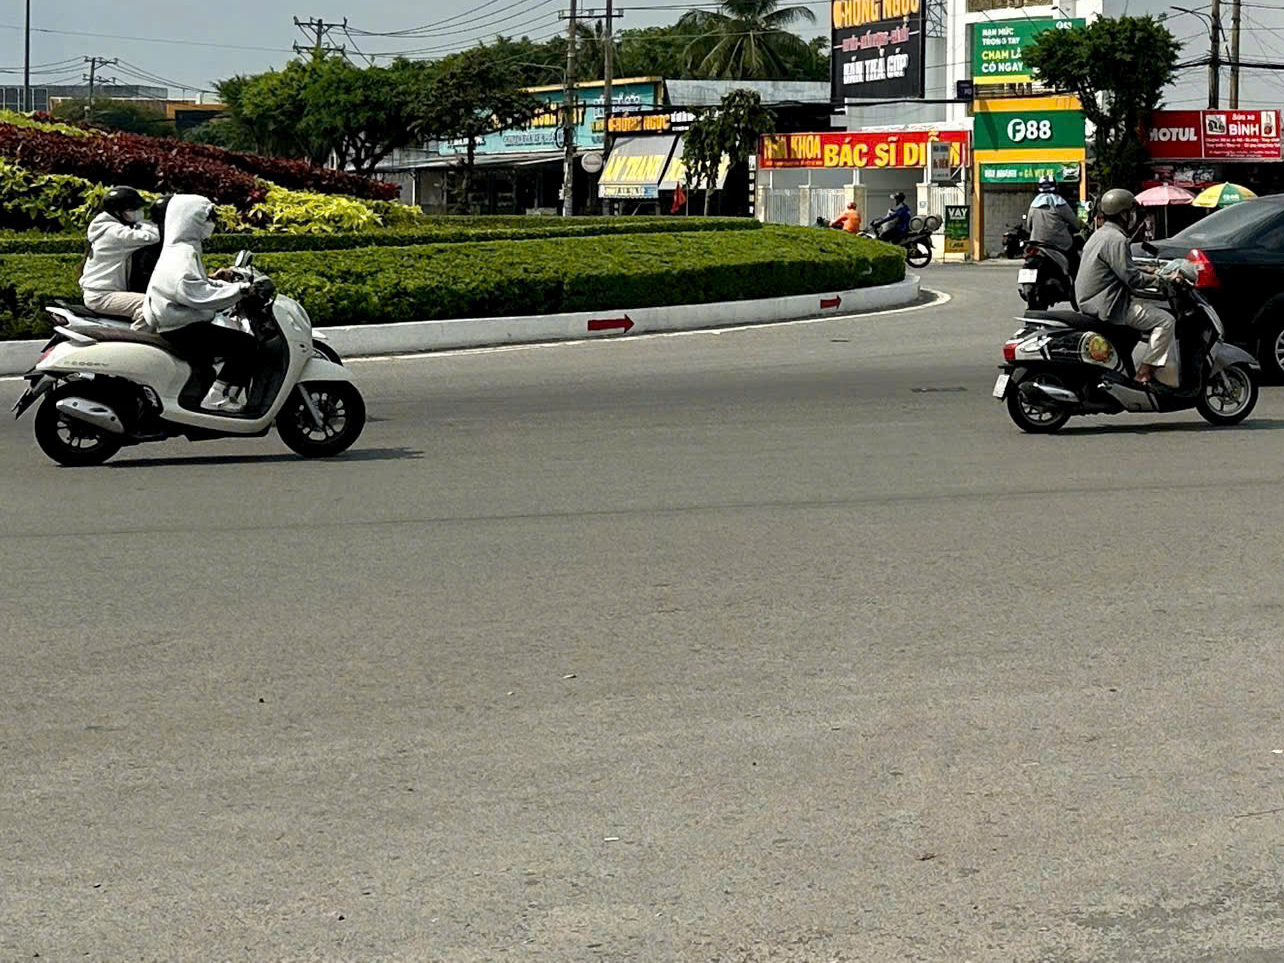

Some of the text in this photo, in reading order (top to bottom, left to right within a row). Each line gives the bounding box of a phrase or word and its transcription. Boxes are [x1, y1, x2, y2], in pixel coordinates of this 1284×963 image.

[982, 61, 1024, 73] CÓ NGAY
[1228, 121, 1260, 136] BÌNH
[790, 134, 822, 159] KHOA
[823, 137, 869, 167] BÁC
[874, 133, 898, 167] SĨ
[903, 129, 961, 166] DIM
[948, 208, 968, 218] VAY
